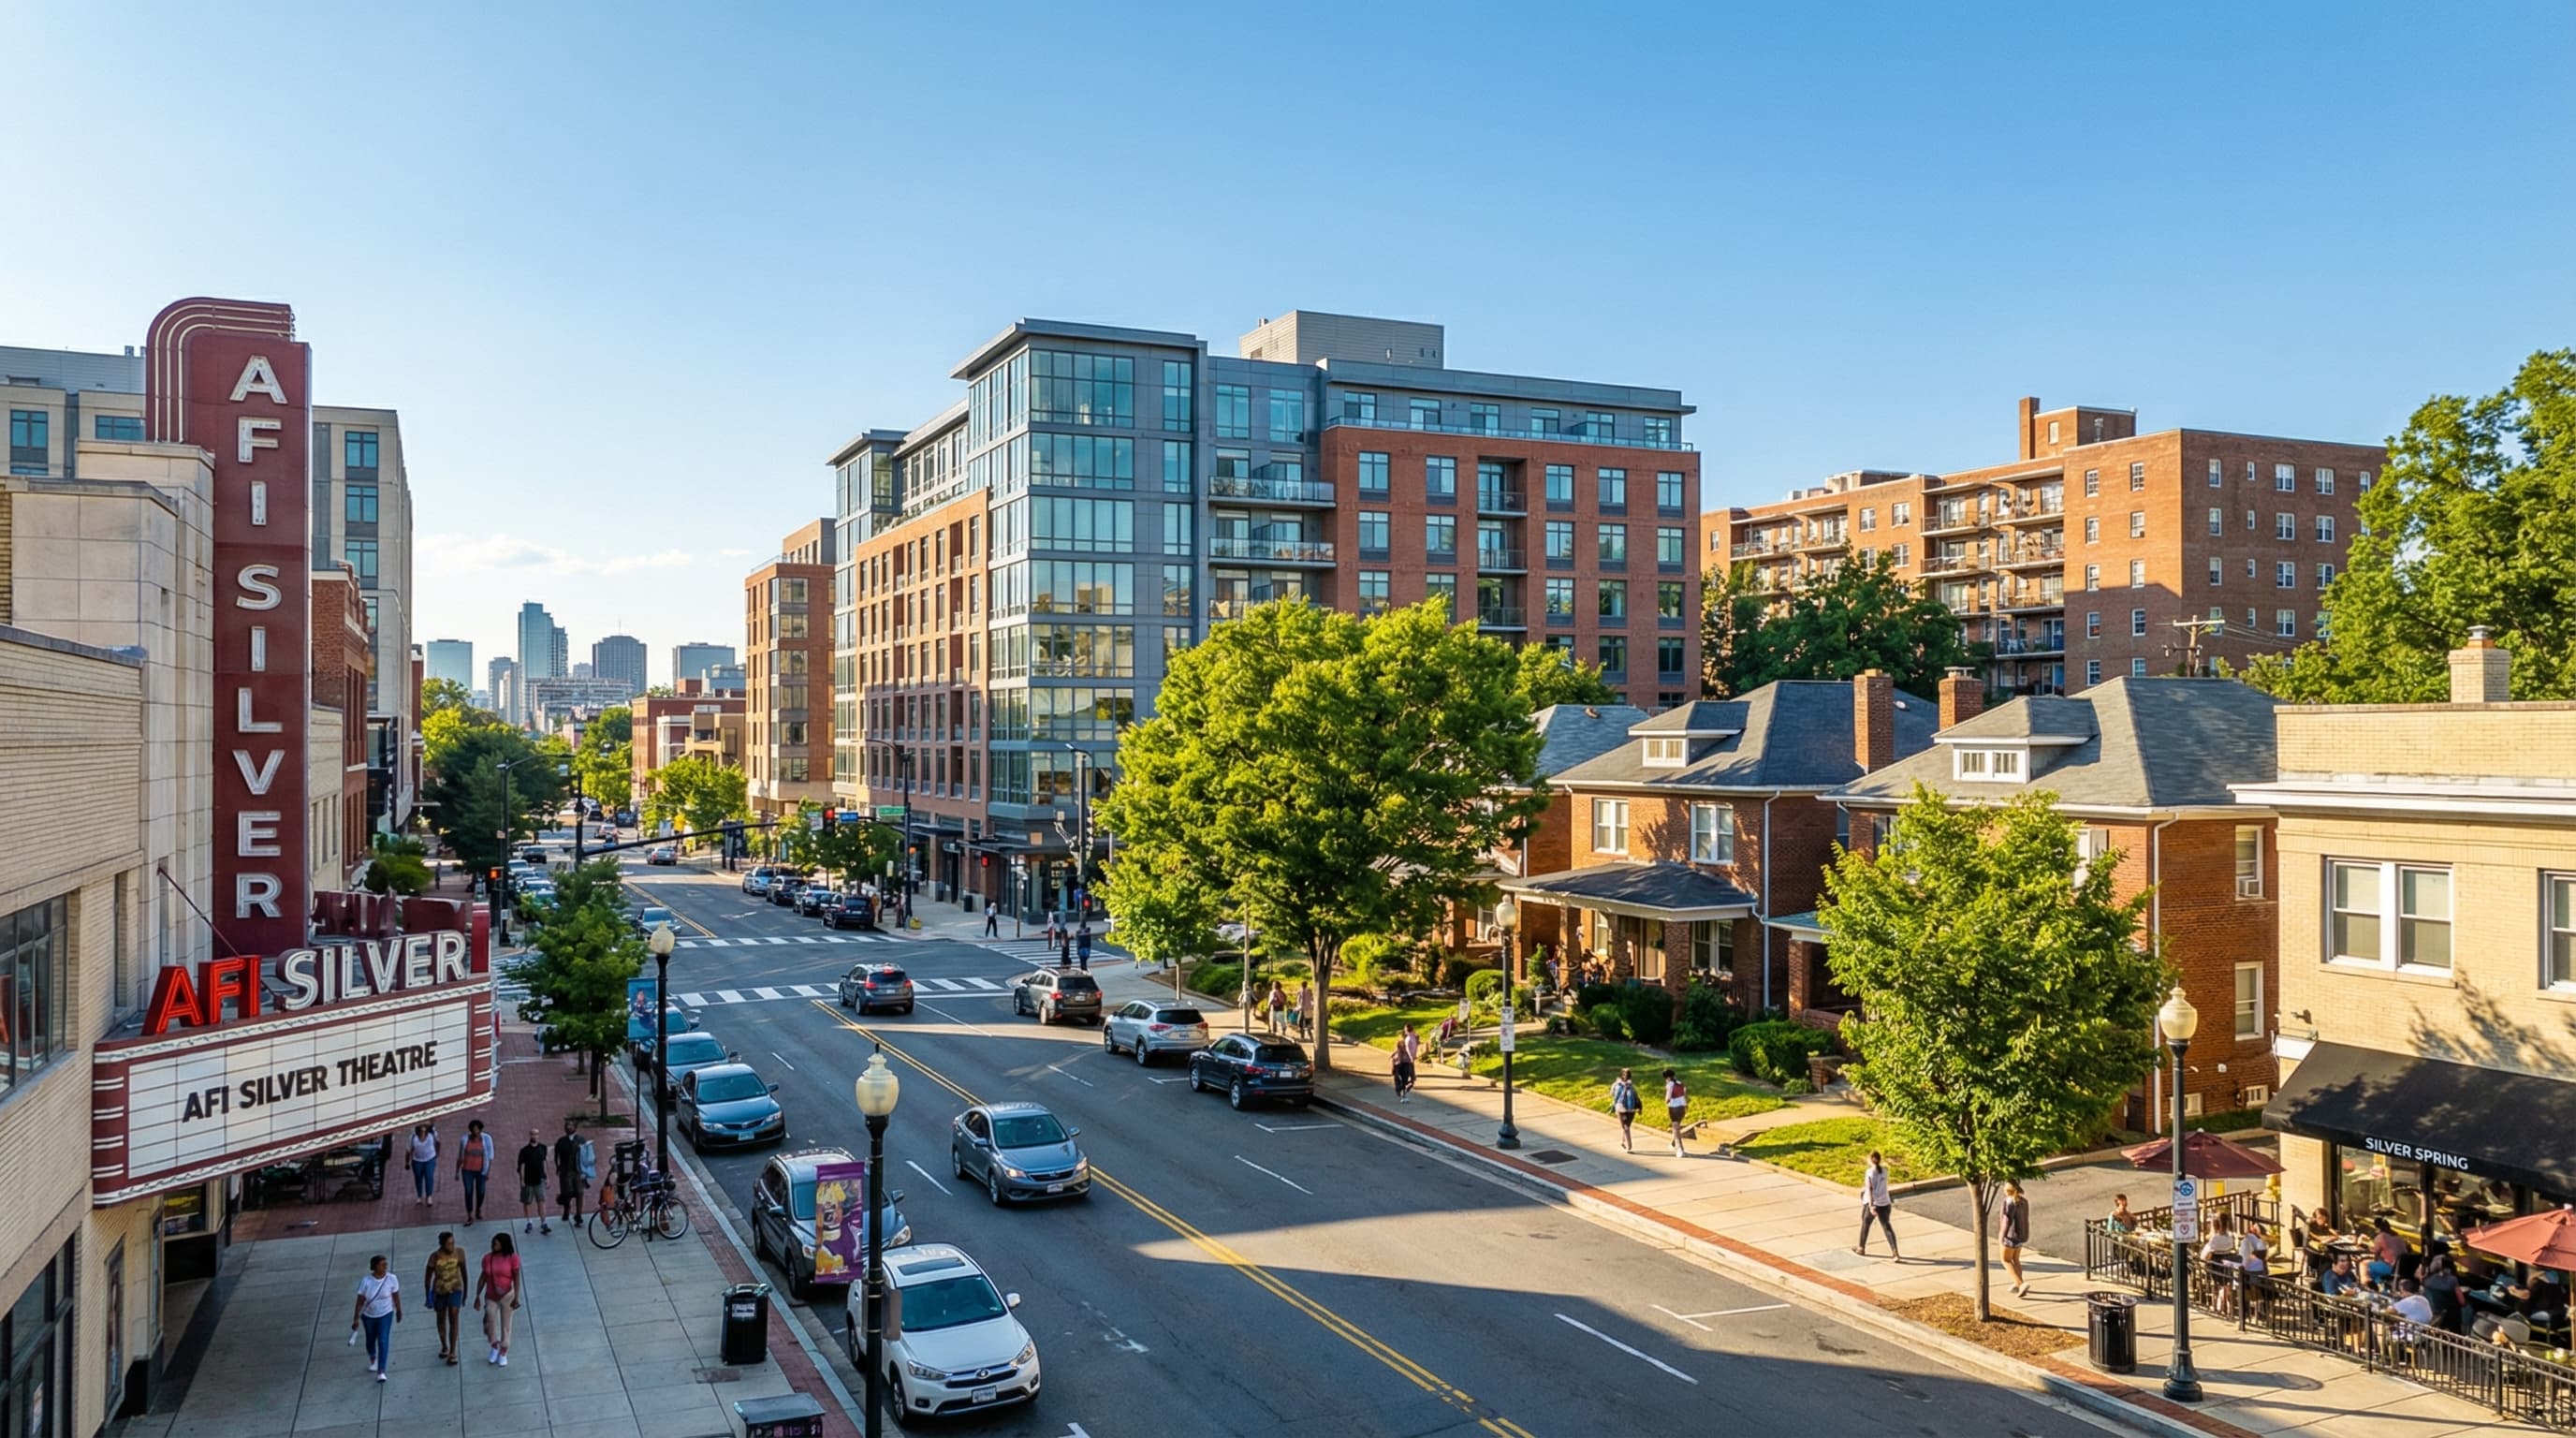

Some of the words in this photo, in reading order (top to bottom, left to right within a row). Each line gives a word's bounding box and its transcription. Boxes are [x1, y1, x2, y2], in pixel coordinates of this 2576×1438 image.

[229, 355, 288, 527] AFI
[233, 564, 284, 919] SILVER
[145, 955, 261, 1034] AFI
[281, 930, 467, 1011] SILVER
[182, 1085, 230, 1123] AFI
[239, 1064, 329, 1109] SILVER
[337, 1040, 438, 1087] THEATRE
[2365, 1137, 2411, 1158] SILVER
[2415, 1148, 2468, 1170] SPRING
